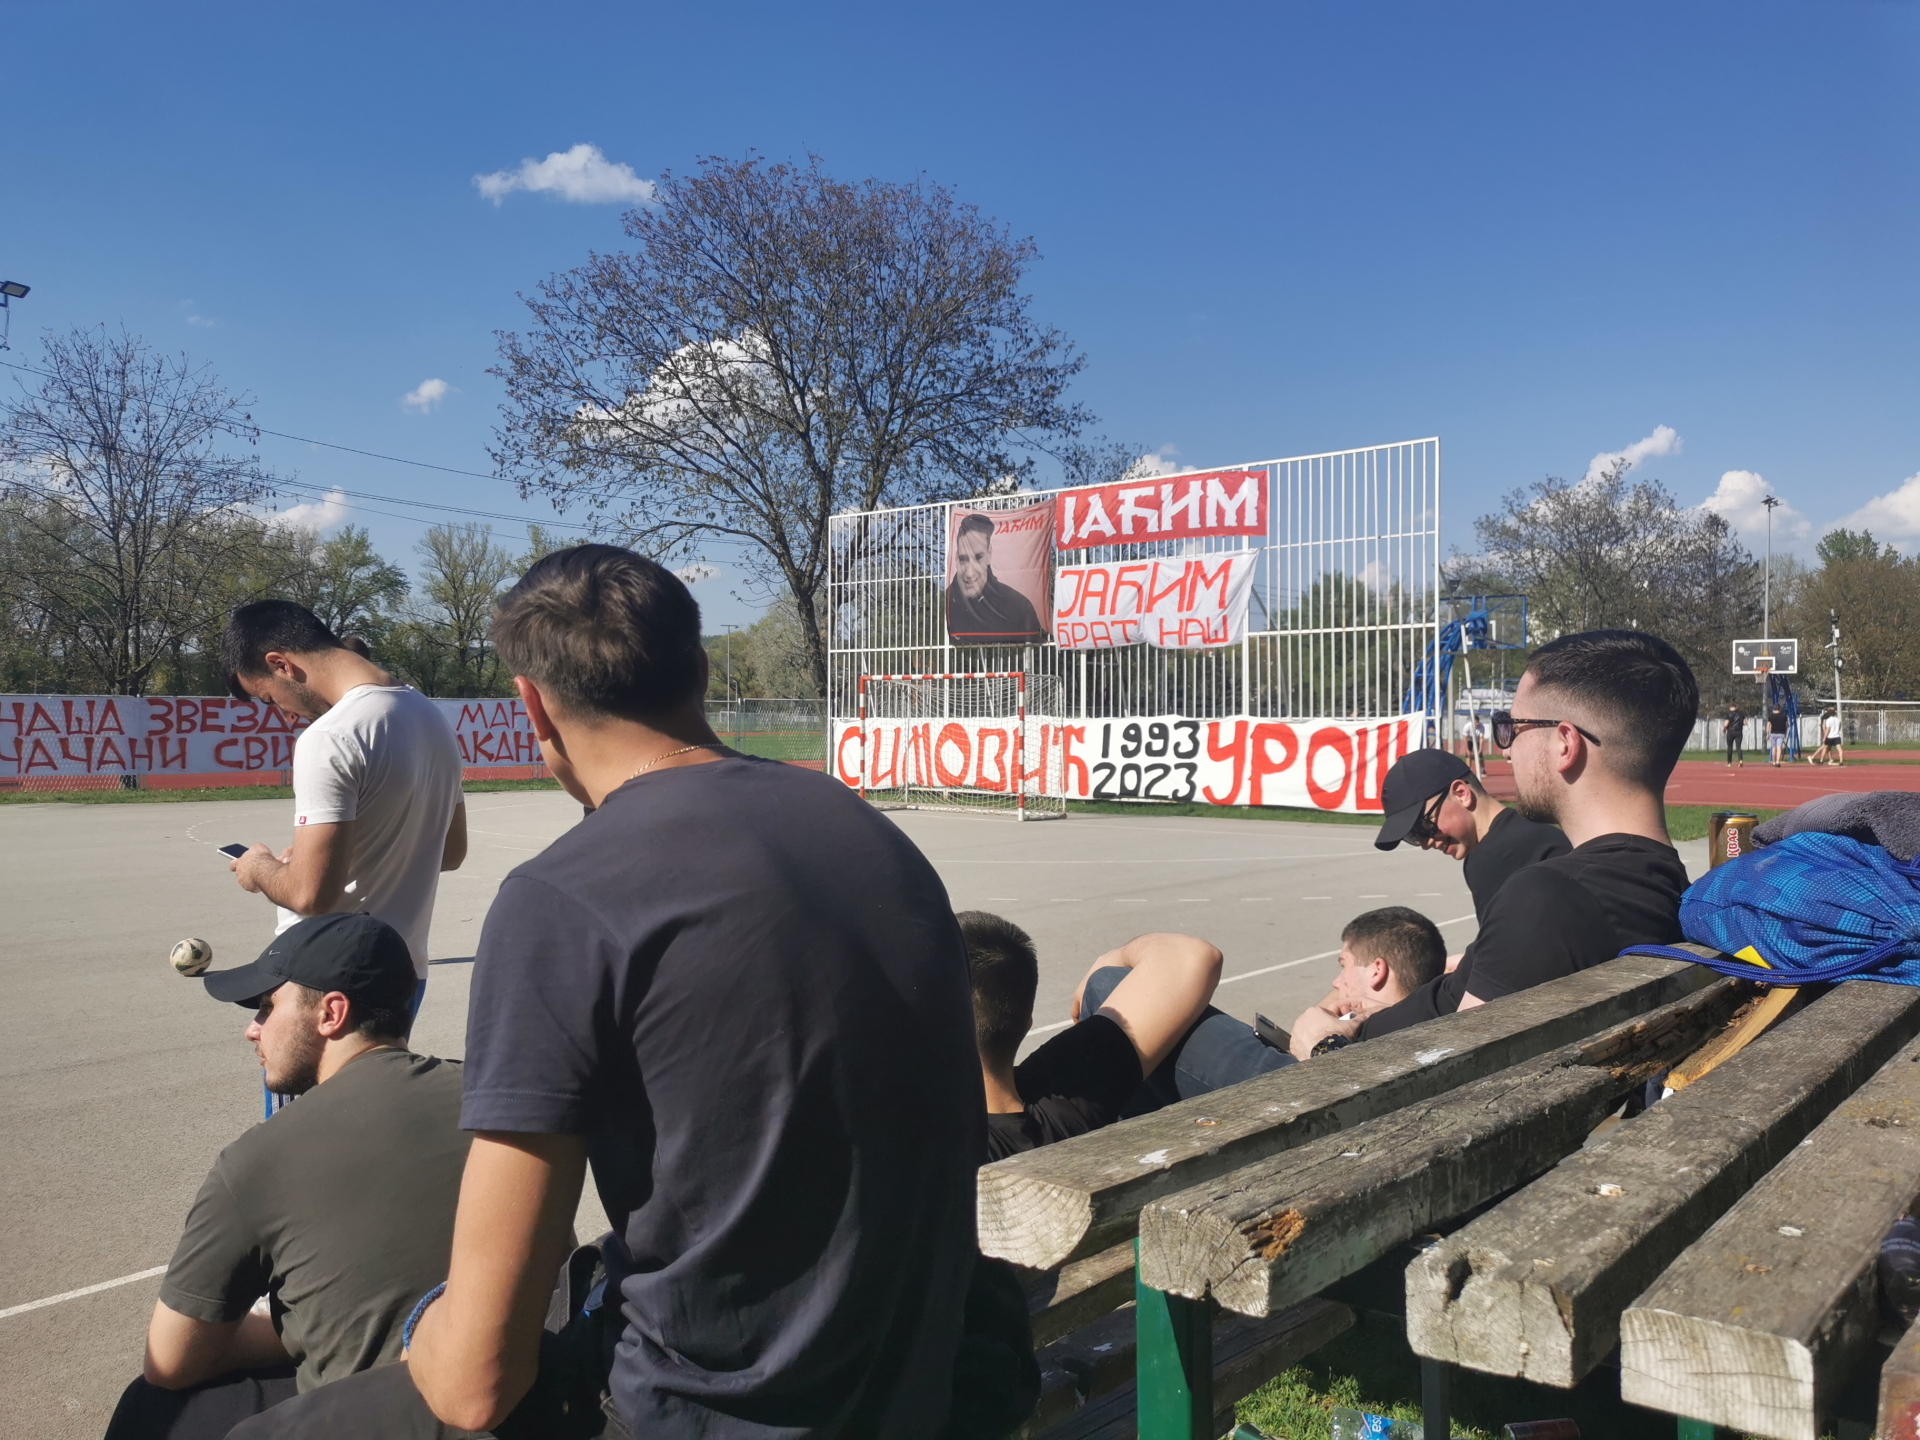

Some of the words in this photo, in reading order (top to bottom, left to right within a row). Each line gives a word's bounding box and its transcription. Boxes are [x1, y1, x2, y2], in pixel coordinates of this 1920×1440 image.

[1057, 619, 1138, 648] БРАТ
[1158, 615, 1228, 646] НАШ
[0, 698, 125, 736] НАША
[1101, 720, 1201, 760] 1993
[1092, 761, 1199, 801] 2023
[1202, 719, 1408, 810] УРОШ
